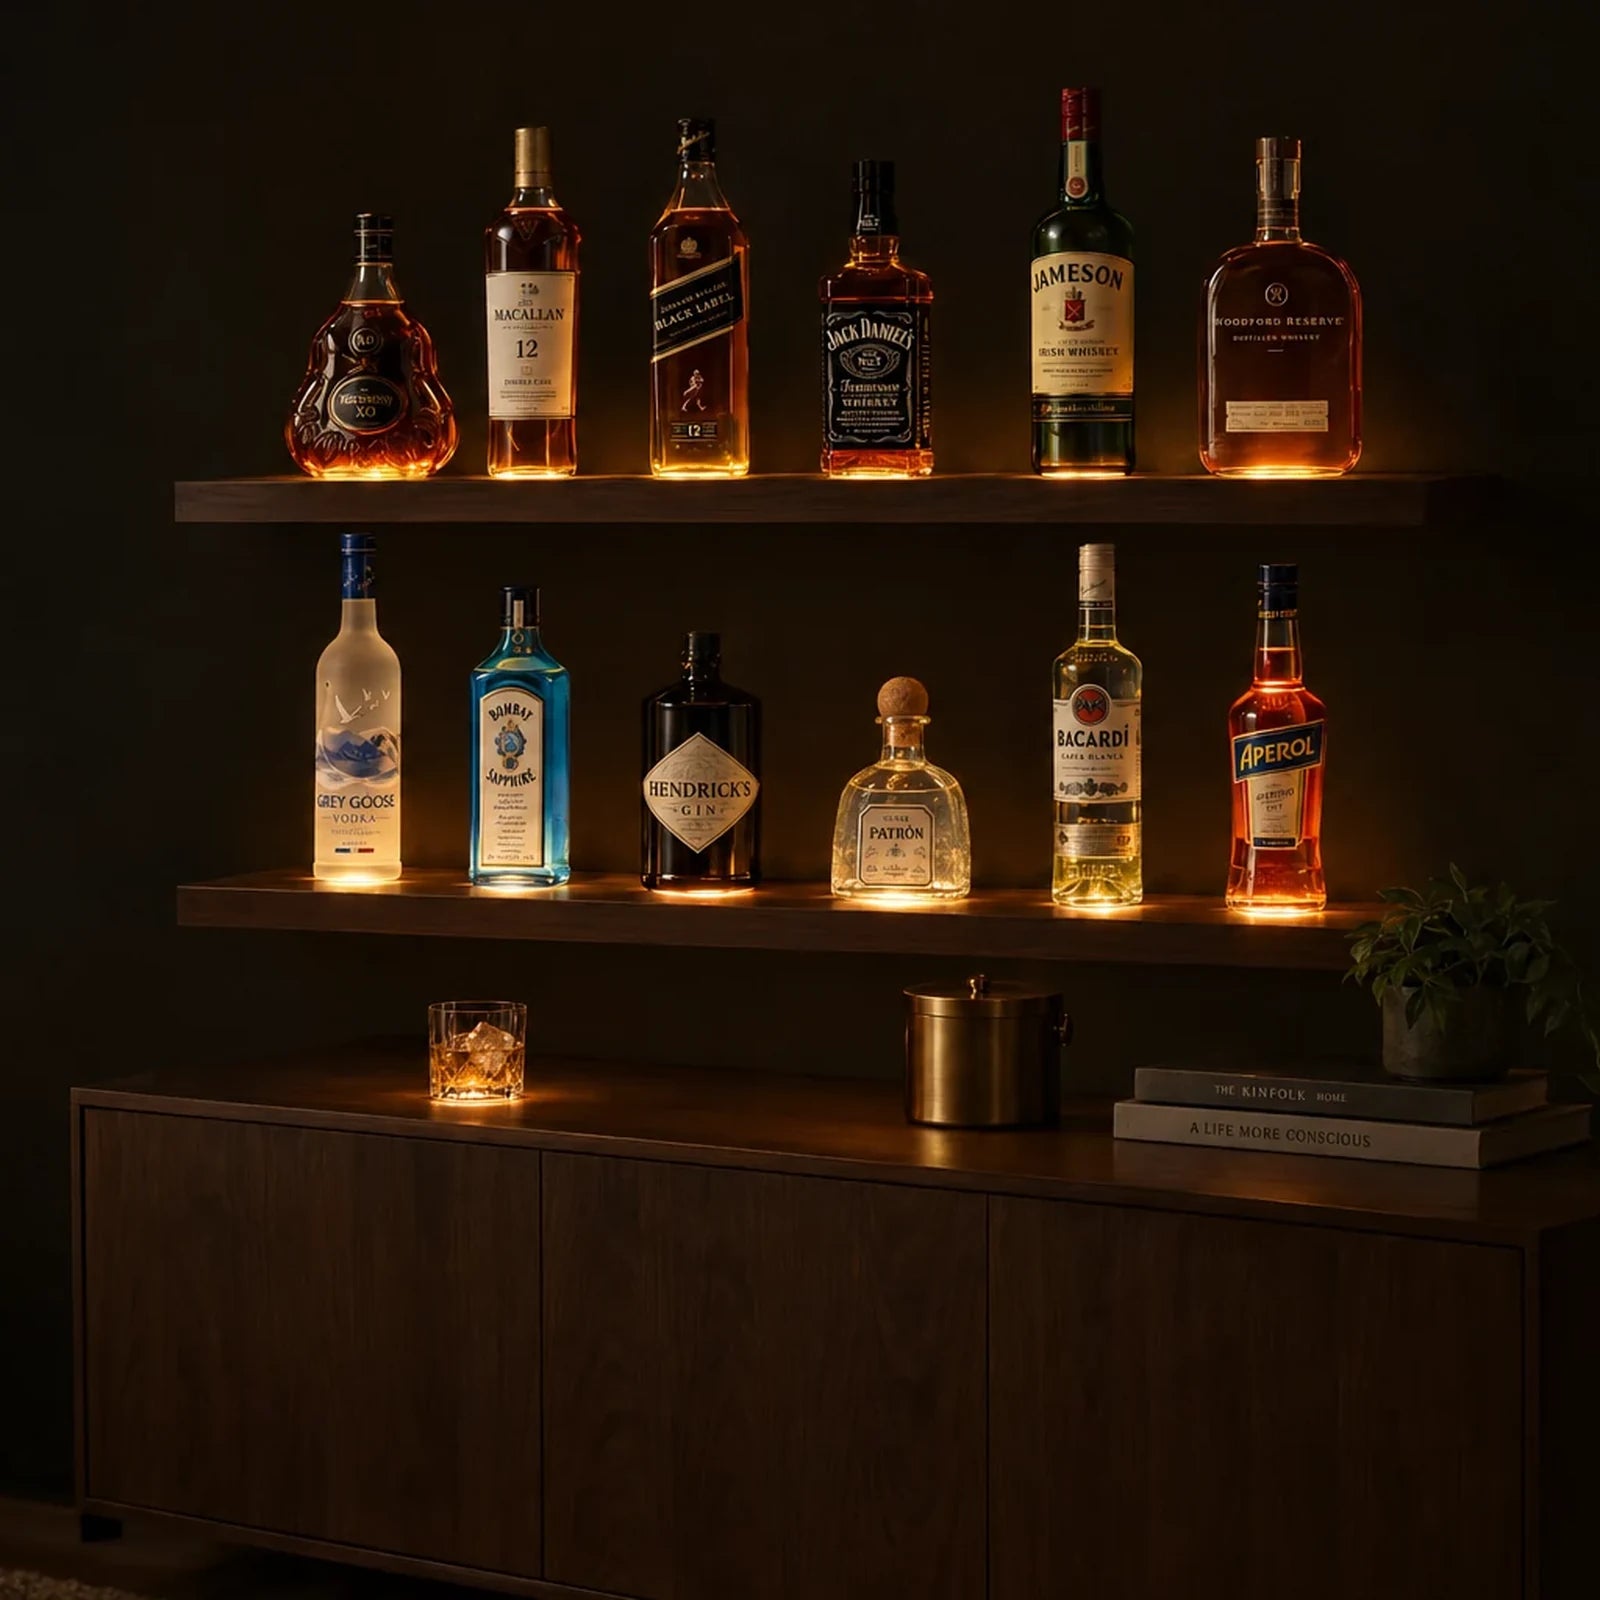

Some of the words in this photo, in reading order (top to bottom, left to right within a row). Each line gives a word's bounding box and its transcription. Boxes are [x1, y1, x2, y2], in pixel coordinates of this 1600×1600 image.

[1033, 263, 1123, 293] JAMESON
[494, 308, 565, 321] MACALLAN
[655, 308, 694, 331] BLACK
[695, 292, 736, 314] LABEL
[826, 324, 863, 351] JACK
[516, 339, 538, 358] 12
[355, 405, 377, 418] XO
[688, 424, 702, 437] 12
[488, 702, 534, 721] BOMBAY
[1057, 723, 1129, 748] BACARDÍ
[1240, 735, 1315, 772] APEROL
[649, 780, 752, 798] HENDRICK'S
[317, 794, 345, 809] GREY
[349, 794, 395, 809] GOOSE
[681, 804, 717, 816] GIN
[332, 813, 376, 824] VODKA
[870, 824, 924, 840] PATRÓN
[1214, 1084, 1235, 1096] THE
[1242, 1085, 1306, 1101] KINFOLK
[1316, 1093, 1348, 1103] HOME
[1190, 1121, 1200, 1134] A
[1204, 1121, 1234, 1137] LIFE
[1239, 1125, 1280, 1141] MORE
[1285, 1128, 1372, 1148] CONSCIOUS
